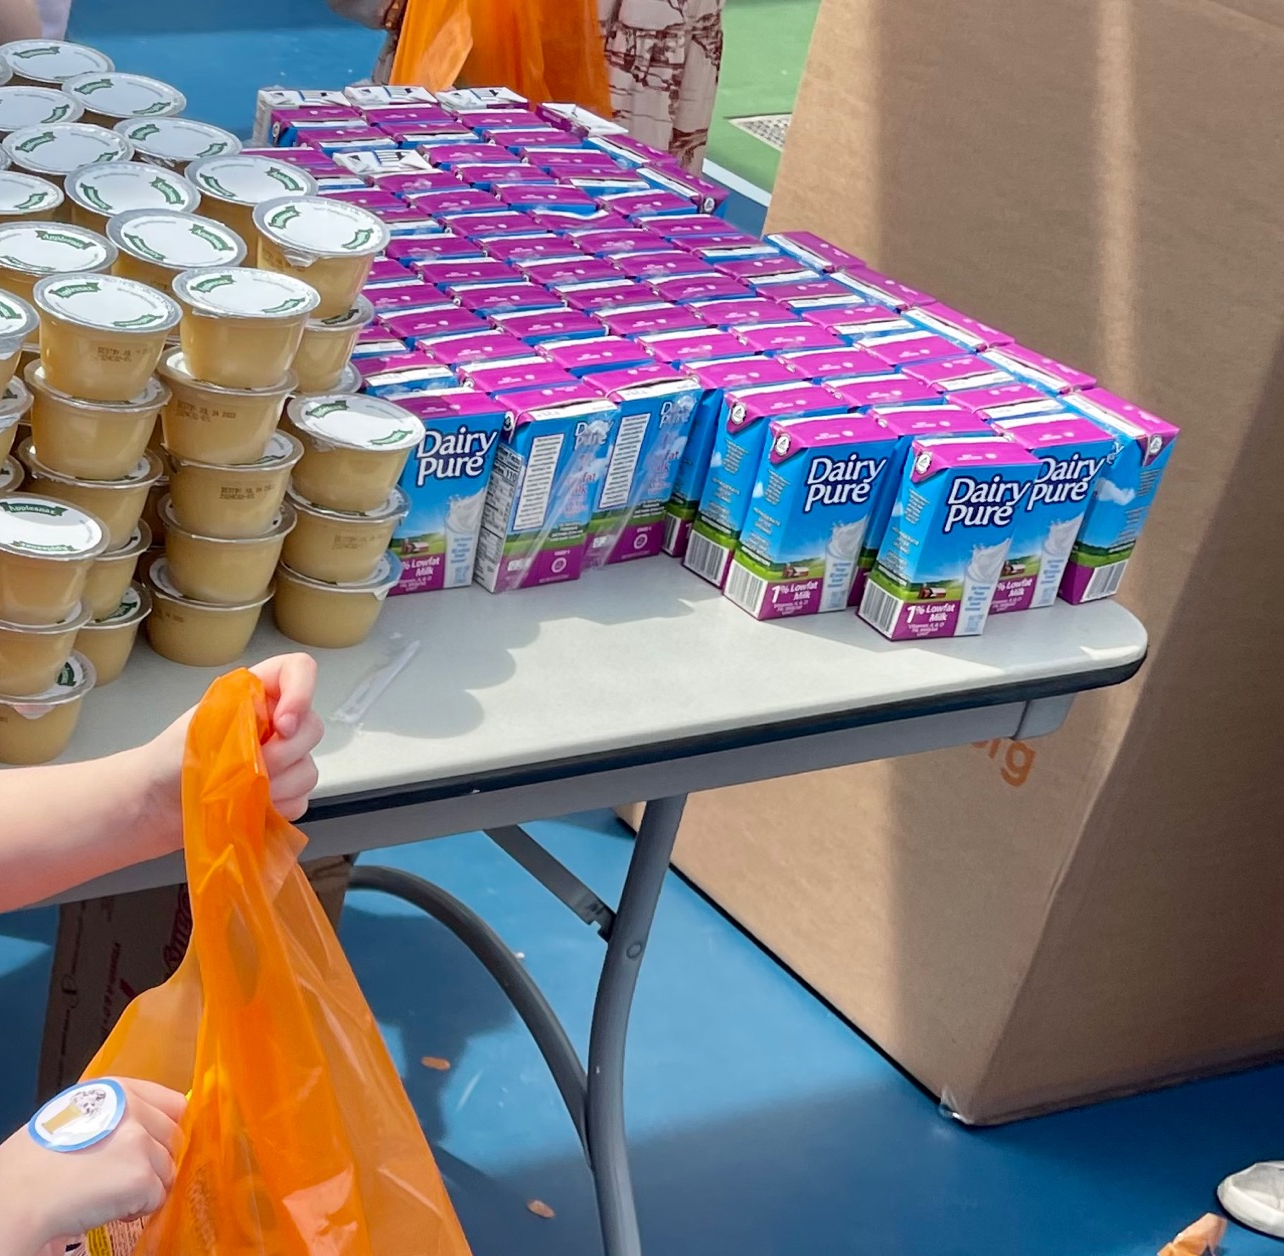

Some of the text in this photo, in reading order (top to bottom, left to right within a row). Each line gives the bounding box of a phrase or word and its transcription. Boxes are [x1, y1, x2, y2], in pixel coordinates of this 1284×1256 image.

[416, 426, 498, 459] Dairy
[807, 454, 887, 485] Dairy
[1034, 453, 1106, 483] Dairy
[947, 476, 1032, 507] Dairy
[411, 556, 440, 567] Lowfat
[416, 566, 434, 576] Milk
[1006, 577, 1033, 589] Lowfat
[772, 582, 818, 603] 1% Lowfat
[793, 591, 811, 601] Milk
[1008, 587, 1025, 597] Milk
[906, 603, 956, 624] 1% Lowfat
[928, 612, 948, 623] Milk
